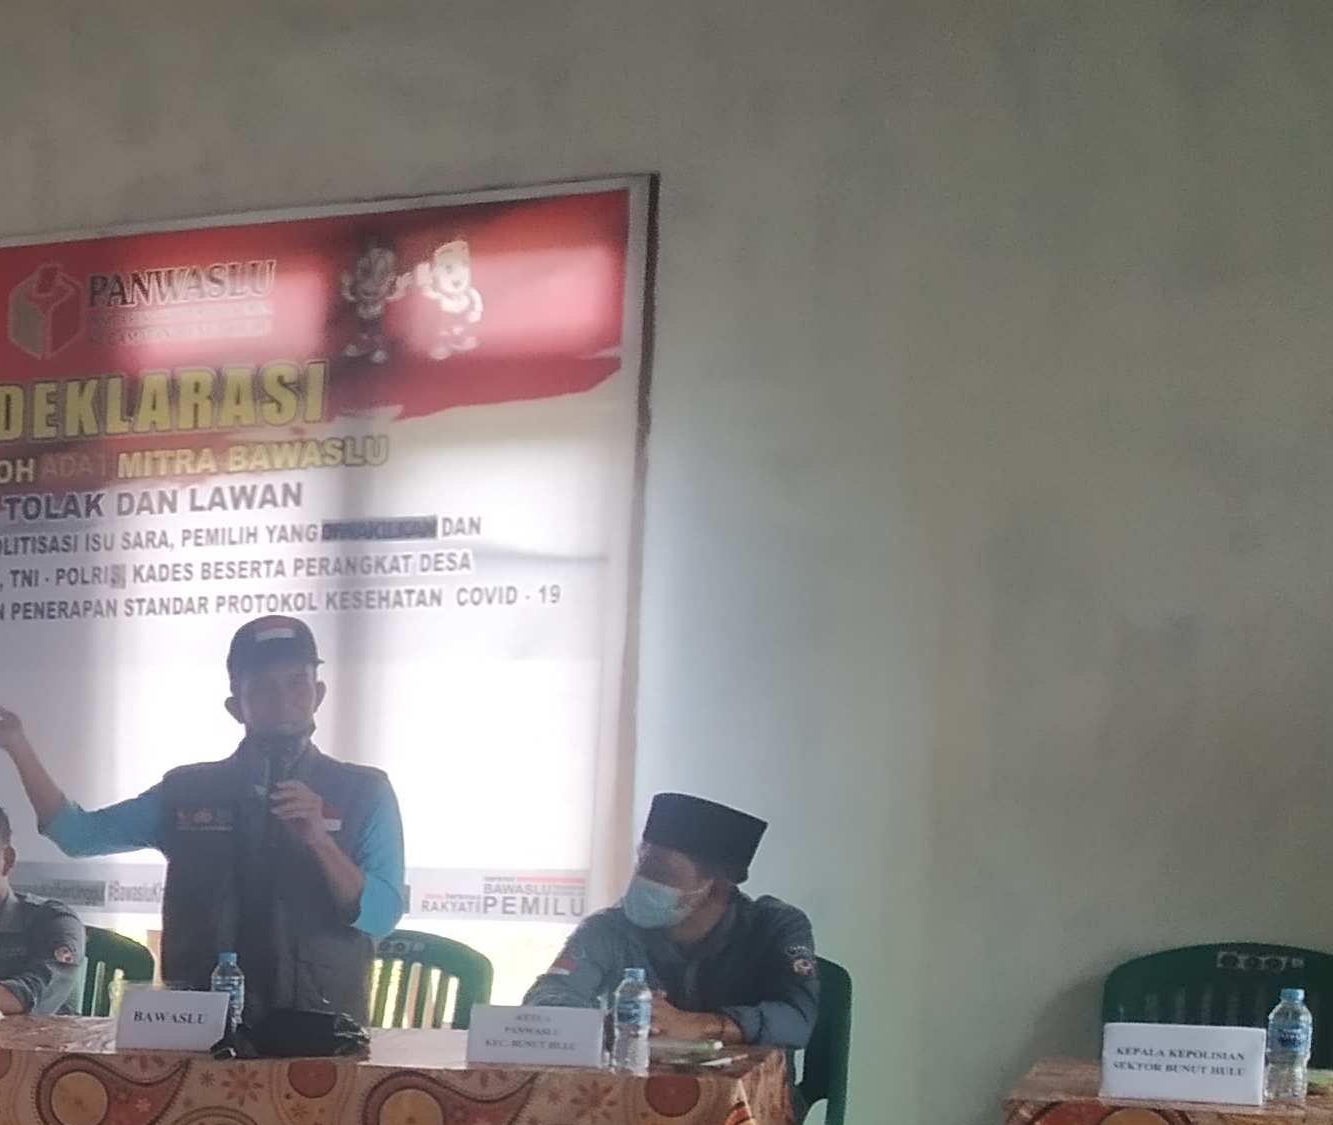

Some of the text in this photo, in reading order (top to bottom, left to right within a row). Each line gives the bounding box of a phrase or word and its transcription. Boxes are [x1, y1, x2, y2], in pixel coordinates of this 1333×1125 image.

[88, 261, 276, 307] PANWASLU
[117, 448, 217, 480] MITRA
[226, 435, 390, 473] BAWASLU
[3, 482, 303, 521] TOLAK DAN LAWAN
[85, 531, 115, 552] ISU
[121, 528, 176, 551] SARA,
[181, 525, 258, 548] PEMILIH
[265, 522, 319, 544] YANG
[441, 516, 482, 538] DAN
[10, 568, 39, 589] TNI
[132, 560, 195, 584] KADES
[200, 557, 286, 581] BESERTA
[293, 554, 412, 578] PERANGKAT
[419, 551, 473, 574] DESA
[11, 599, 118, 622] PENERAPAN
[123, 594, 209, 618] STANDAR
[215, 591, 318, 615] PROTOKOL
[325, 588, 443, 612] KESEHATAN
[455, 586, 519, 608] COVID
[538, 584, 561, 605] 19
[483, 883, 552, 896] BAWASLU
[421, 900, 476, 914] RAKYAT
[483, 896, 585, 917] PEMILU
[133, 1011, 208, 1024] BAWASLU
[1113, 1060, 1162, 1072] SEKTOR
[1165, 1063, 1208, 1075] BUNUT
[1116, 1047, 1245, 1061] KEPALA KEPOLISIAN
